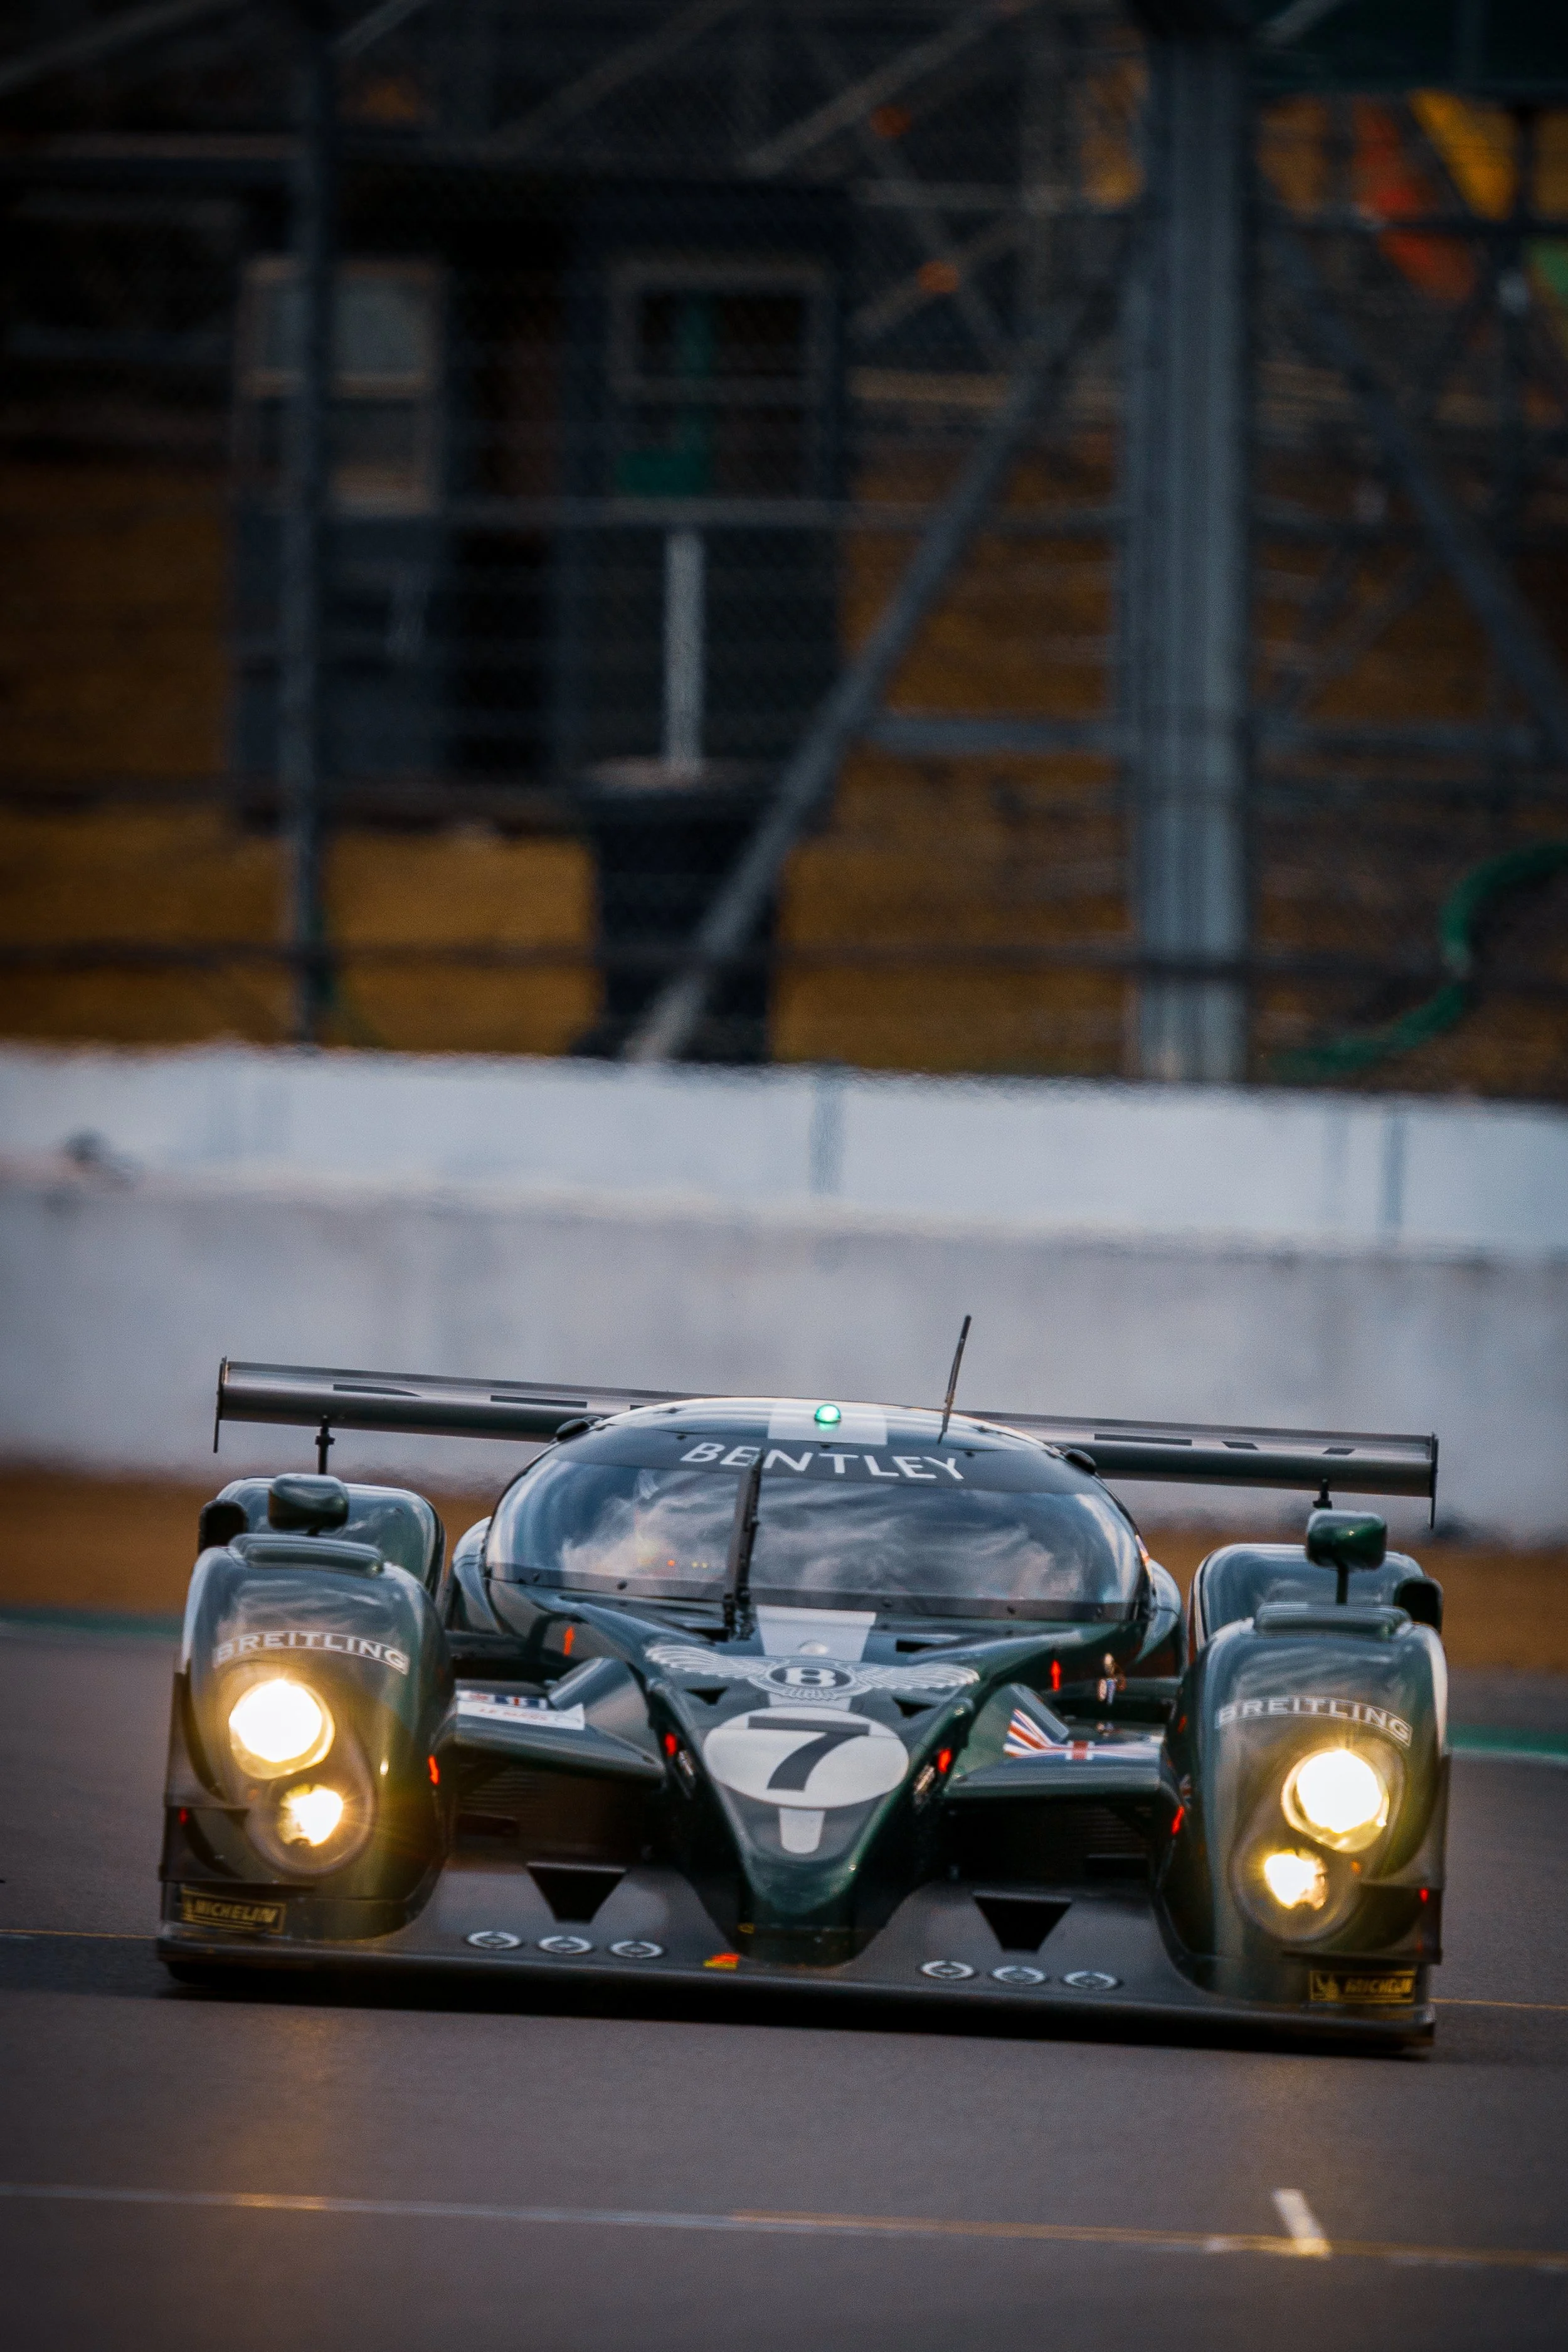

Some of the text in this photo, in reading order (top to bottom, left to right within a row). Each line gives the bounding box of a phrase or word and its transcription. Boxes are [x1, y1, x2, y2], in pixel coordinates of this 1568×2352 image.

[681, 1442, 964, 1481] BENTLEY
[217, 1632, 407, 1672] BREITLING
[1219, 1696, 1411, 1741] BREITLING
[748, 1715, 870, 1792] 7
